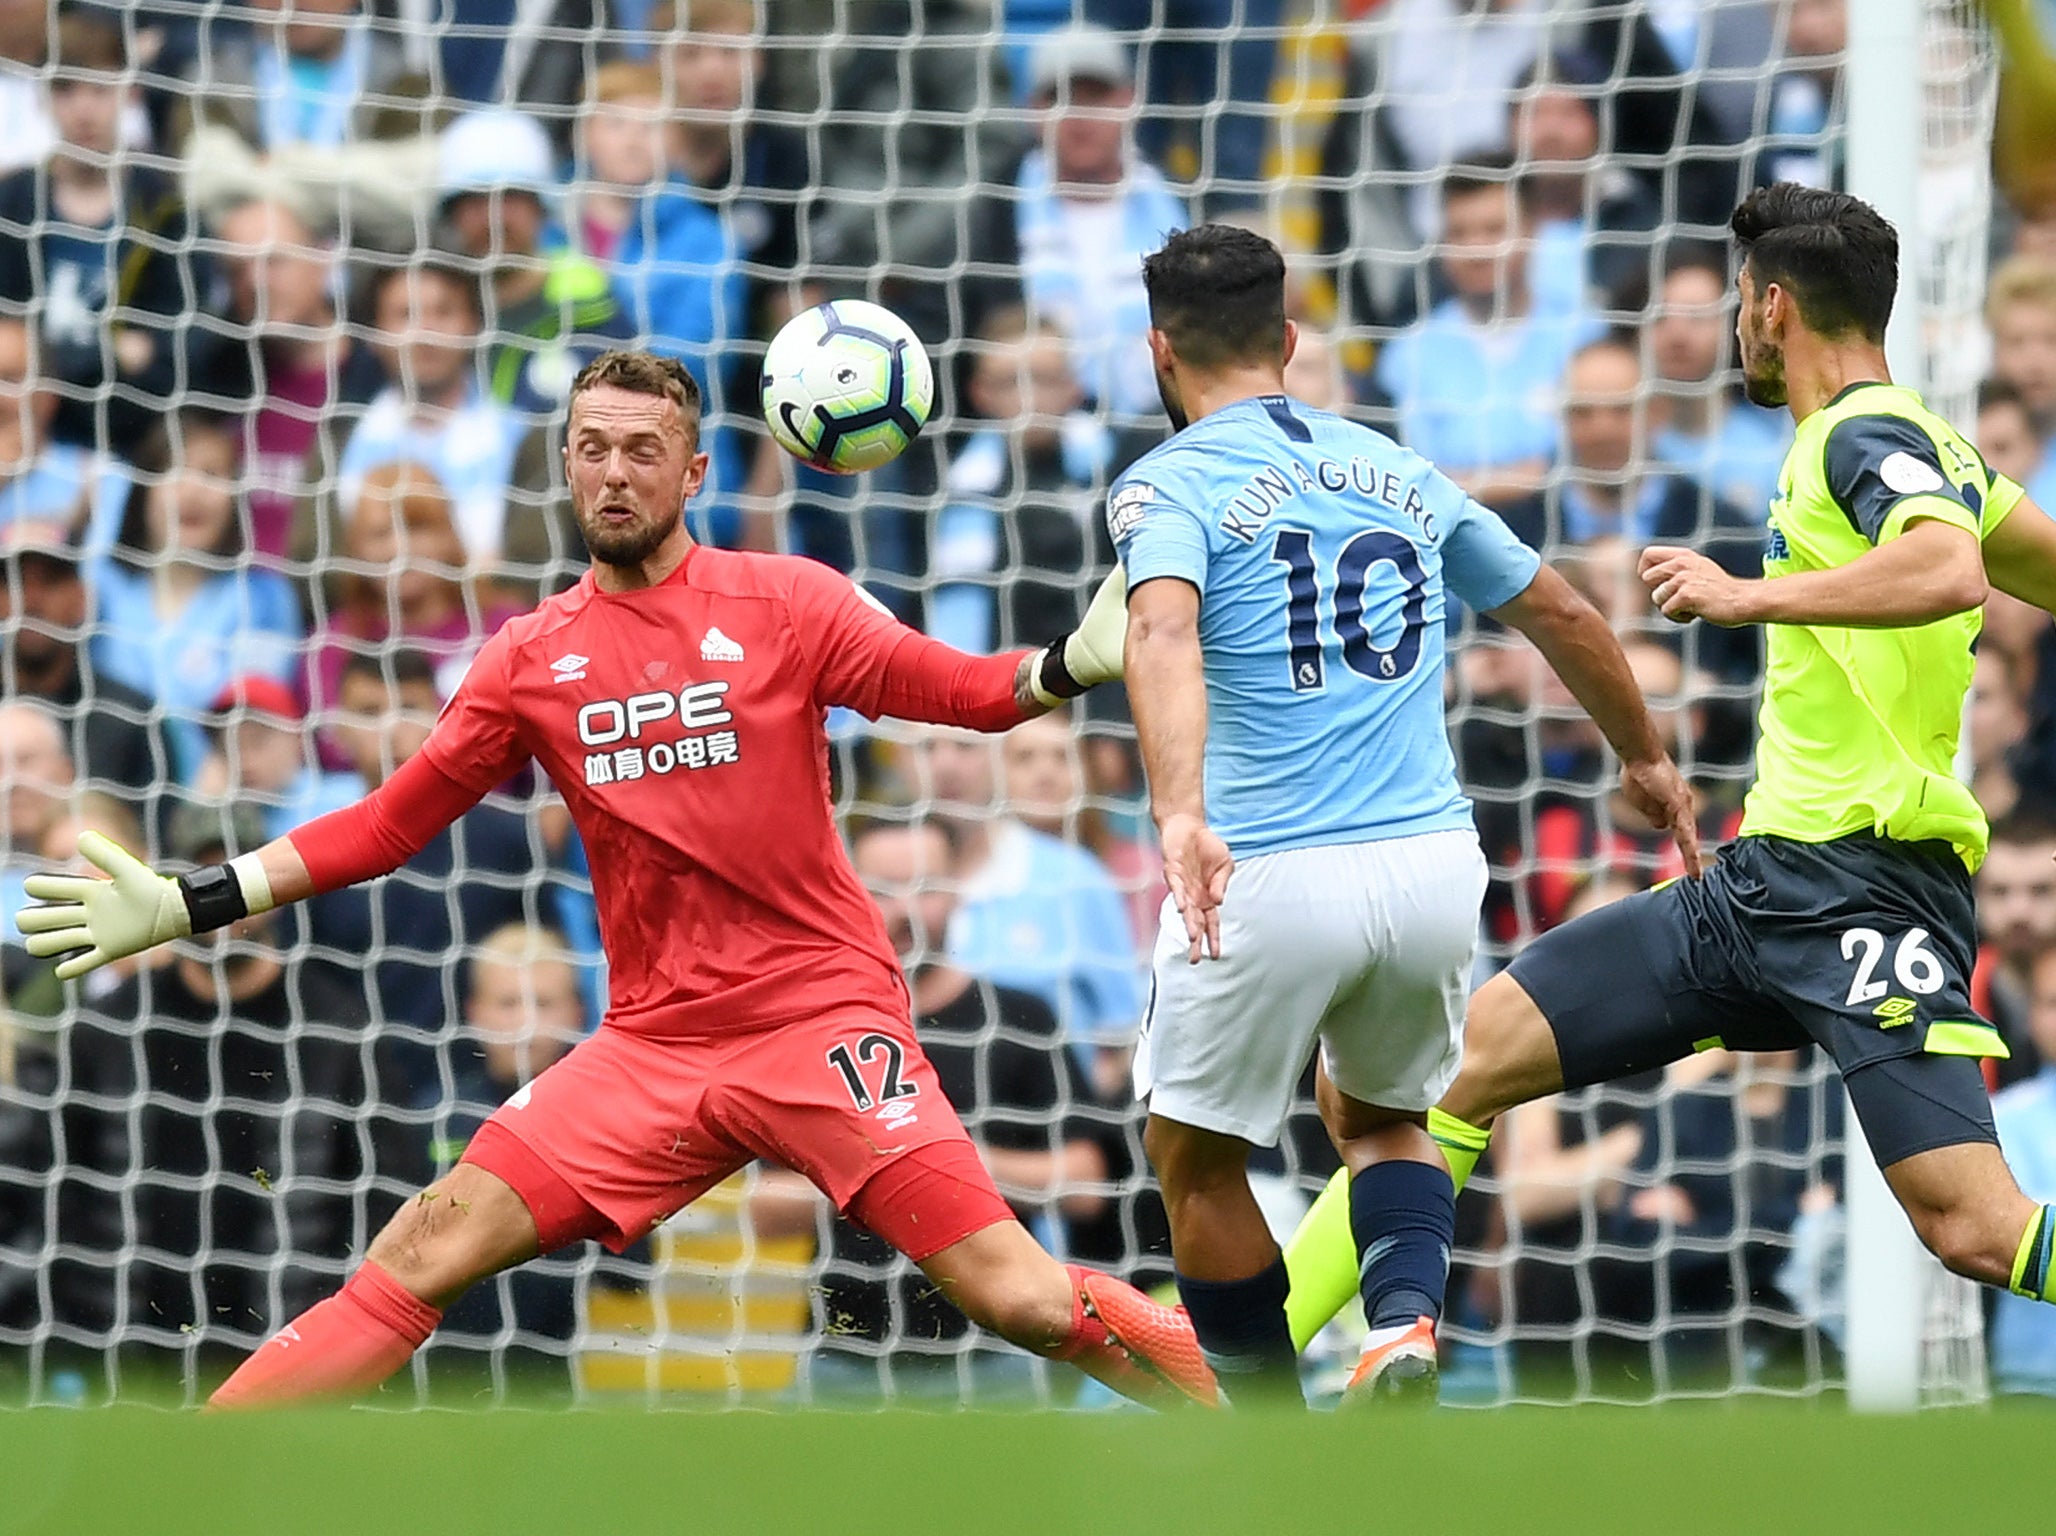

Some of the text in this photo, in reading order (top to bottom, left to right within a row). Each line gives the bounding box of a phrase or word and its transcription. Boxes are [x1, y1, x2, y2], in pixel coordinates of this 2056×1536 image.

[1111, 503, 1145, 535] IRE
[1220, 466, 1294, 544] KUN
[1272, 528, 1428, 692] 10
[577, 681, 733, 746] OPE
[1840, 927, 1945, 1007] 26
[1879, 1014, 1915, 1030] umbro
[825, 1032, 920, 1112] 12
